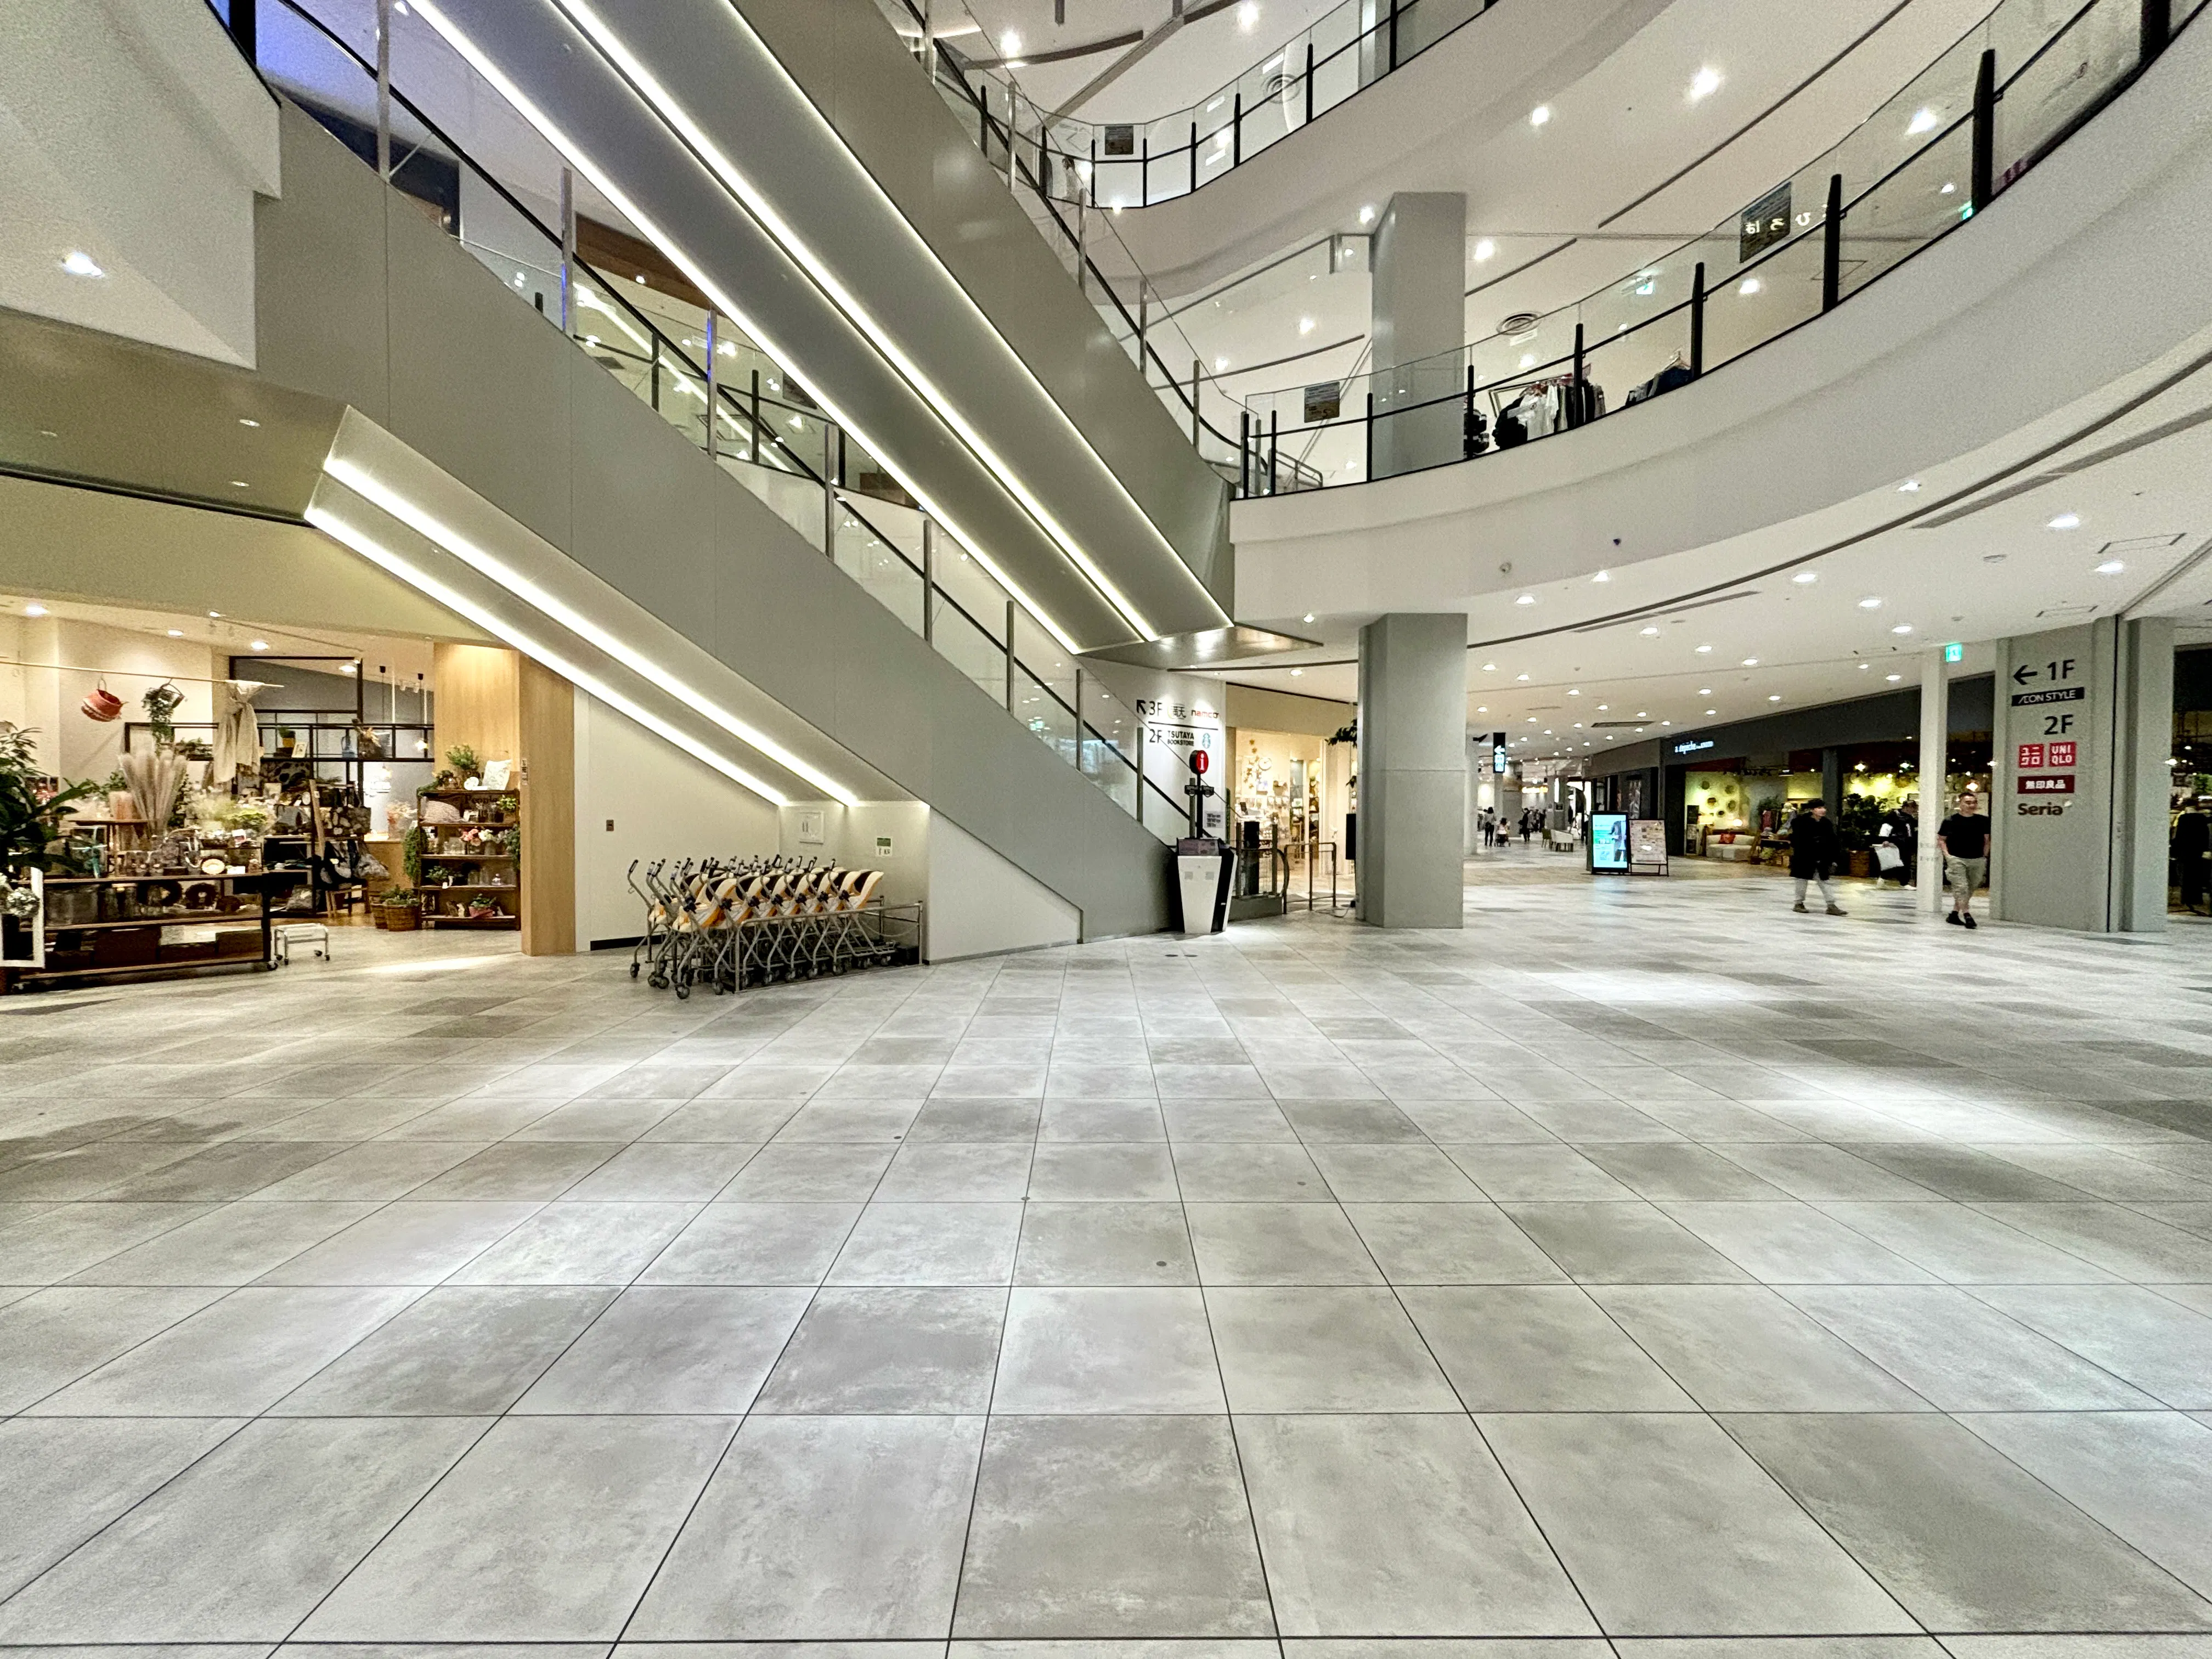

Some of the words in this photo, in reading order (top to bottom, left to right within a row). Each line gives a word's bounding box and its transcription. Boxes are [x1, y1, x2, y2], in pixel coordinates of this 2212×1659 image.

[2047, 659, 2075, 680] 1F
[2045, 690, 2076, 701] STYLE
[1149, 701, 1163, 716] 3F
[1192, 709, 1219, 719] namco
[2044, 714, 2073, 735] 2F
[1149, 729, 1163, 743] 2F
[1167, 730, 1194, 740] TSUTAYA
[2025, 780, 2066, 789] 無印良品
[2018, 802, 2063, 816] Seria
